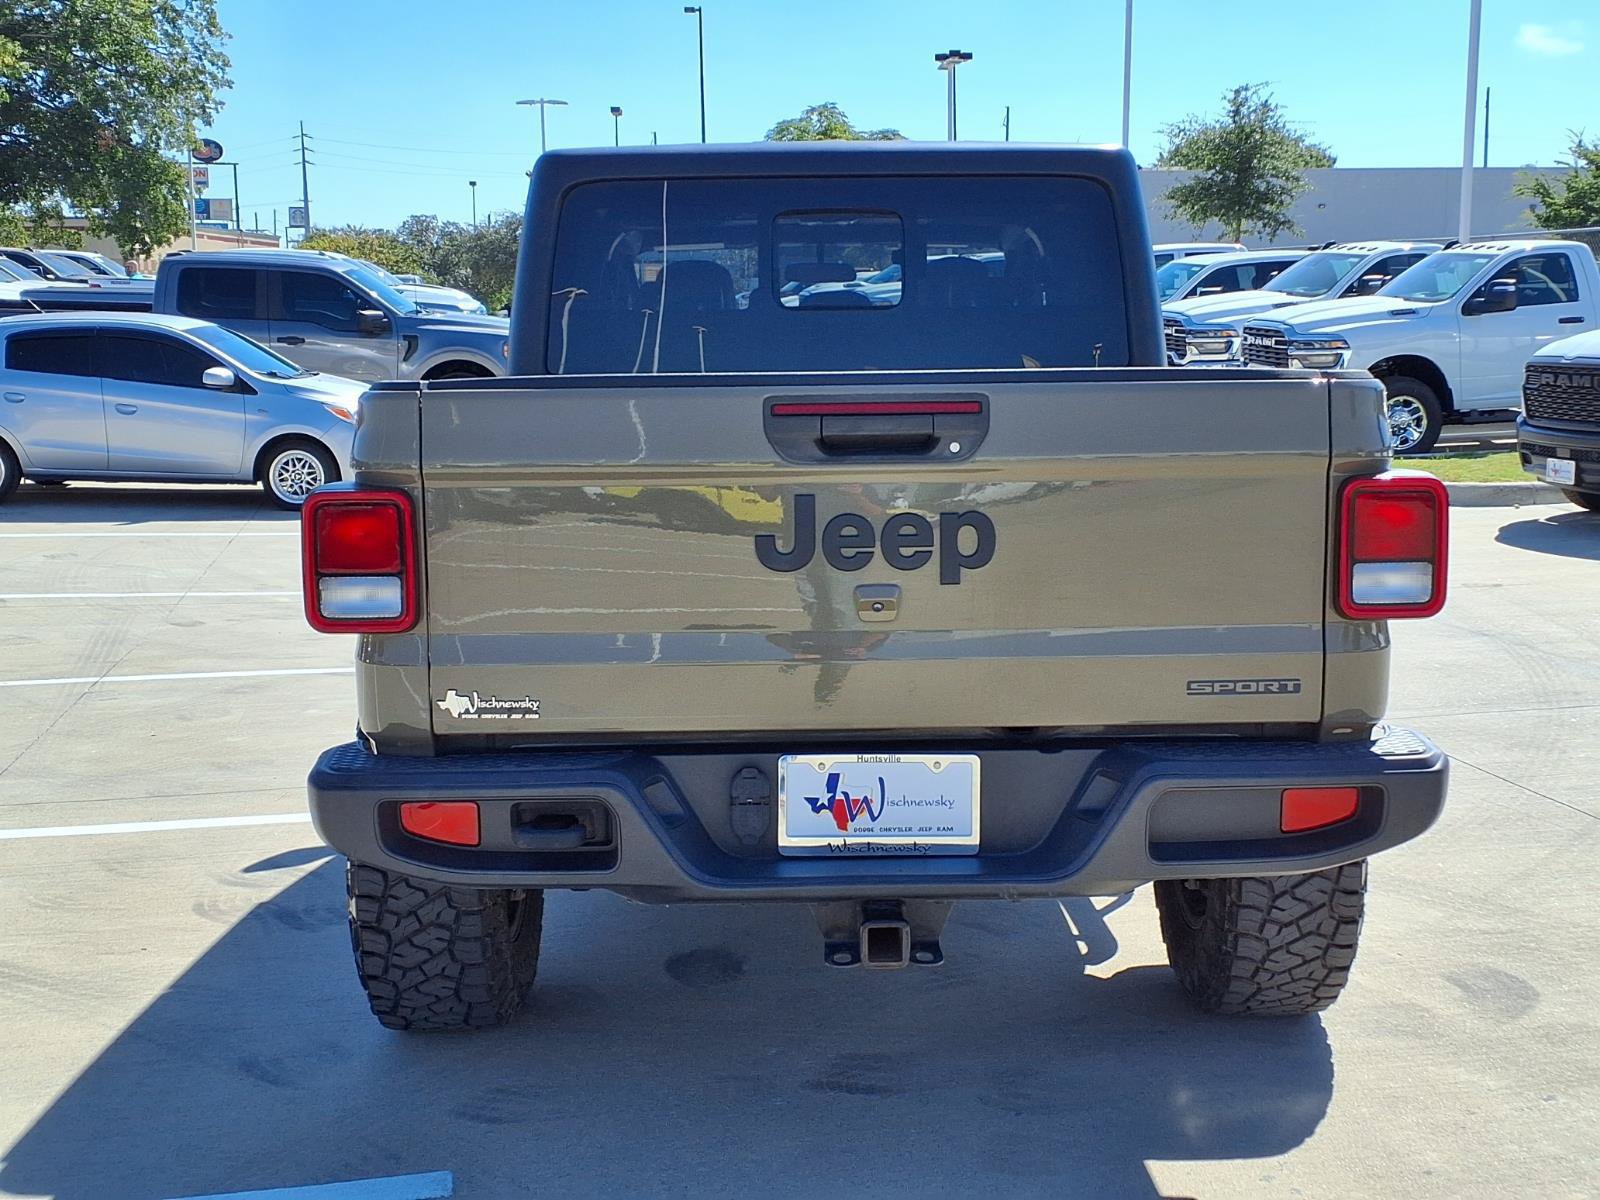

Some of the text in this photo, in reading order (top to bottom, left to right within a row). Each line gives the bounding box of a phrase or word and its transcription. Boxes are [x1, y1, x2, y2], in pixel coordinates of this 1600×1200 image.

[1540, 373, 1592, 387] RAM
[754, 493, 997, 586] Jeep
[1186, 680, 1302, 694] SPORT
[856, 753, 902, 763] Huntsville
[841, 776, 956, 823] Wischnewsky
[827, 838, 932, 855] Wischnewsky
